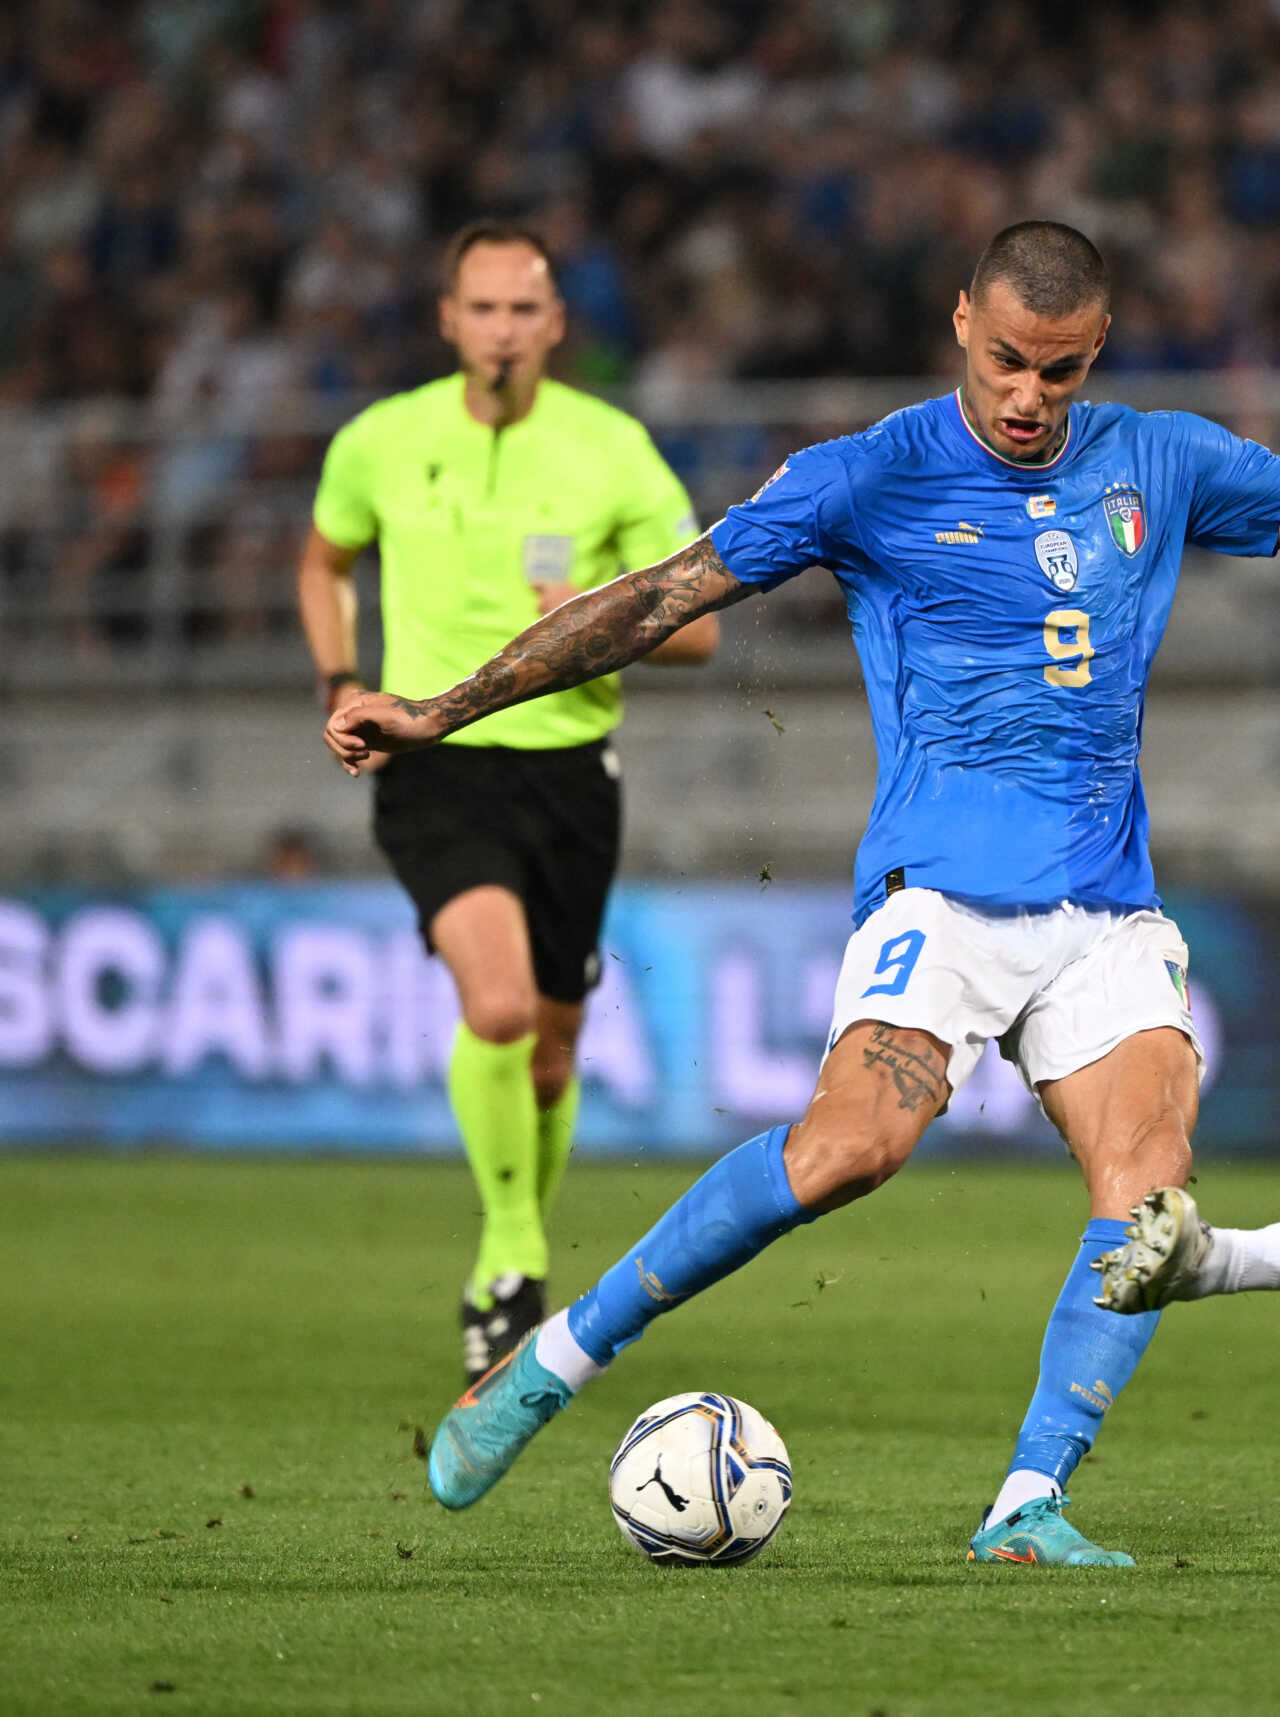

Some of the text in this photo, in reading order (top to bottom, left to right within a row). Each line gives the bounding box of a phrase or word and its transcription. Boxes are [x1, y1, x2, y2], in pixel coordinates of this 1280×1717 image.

[1107, 496, 1139, 510] ITALIA
[935, 531, 979, 545] PUMA
[1043, 609, 1096, 688] 9
[857, 928, 927, 999] 9
